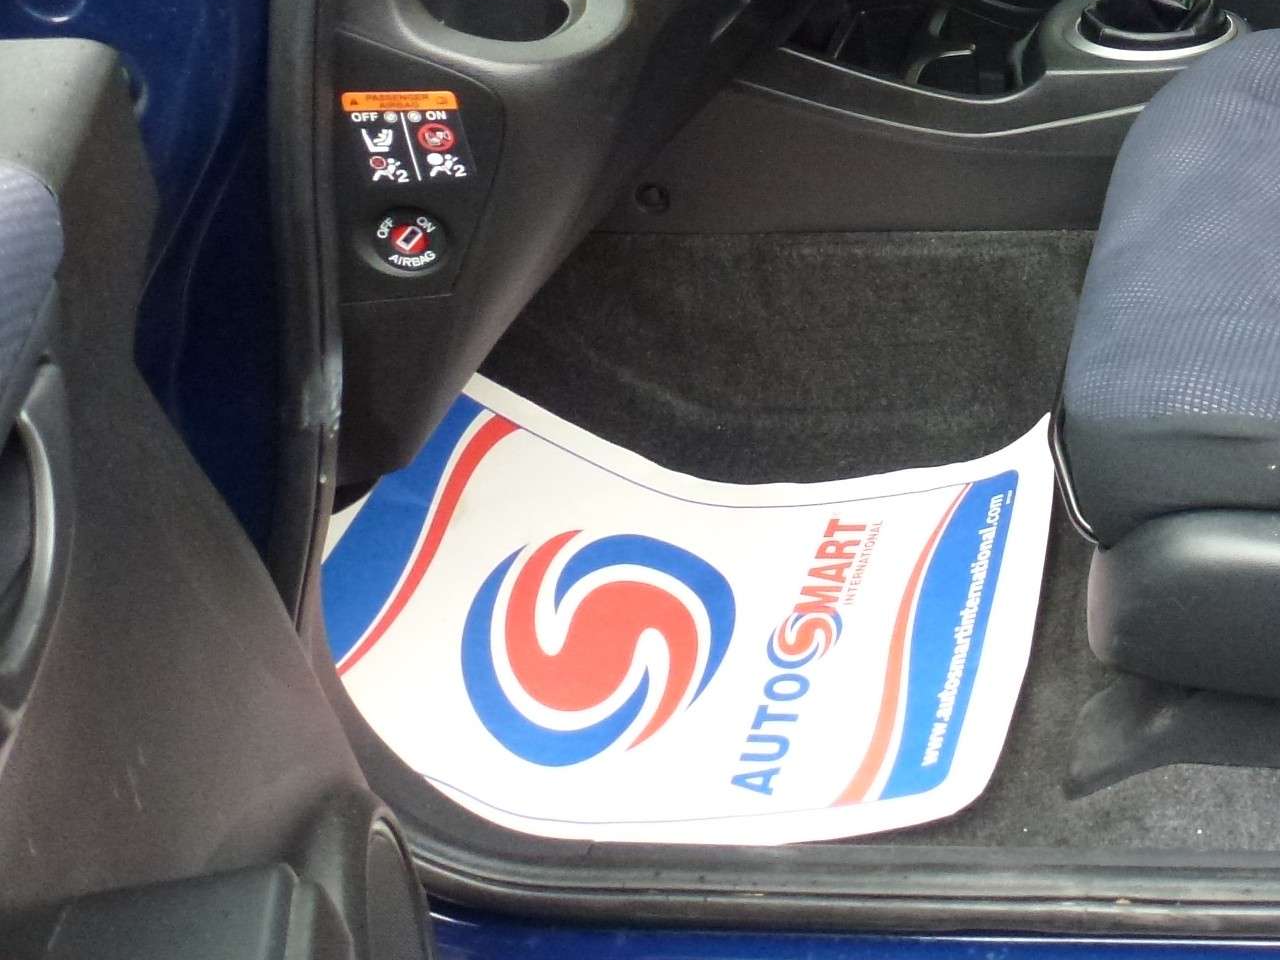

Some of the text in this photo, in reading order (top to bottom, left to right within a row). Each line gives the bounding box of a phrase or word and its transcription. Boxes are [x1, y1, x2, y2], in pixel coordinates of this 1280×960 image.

[365, 93, 429, 101] PASSENGER
[351, 112, 378, 122] OFF
[425, 110, 447, 120] ON
[395, 170, 409, 183] 2
[453, 165, 467, 177] 2
[376, 216, 395, 239] OFF
[416, 216, 436, 233] ON
[388, 250, 436, 267] AIRBAG
[843, 519, 884, 606] INTERNATIONAL
[920, 493, 1004, 768] www.autosmartinternational.com
